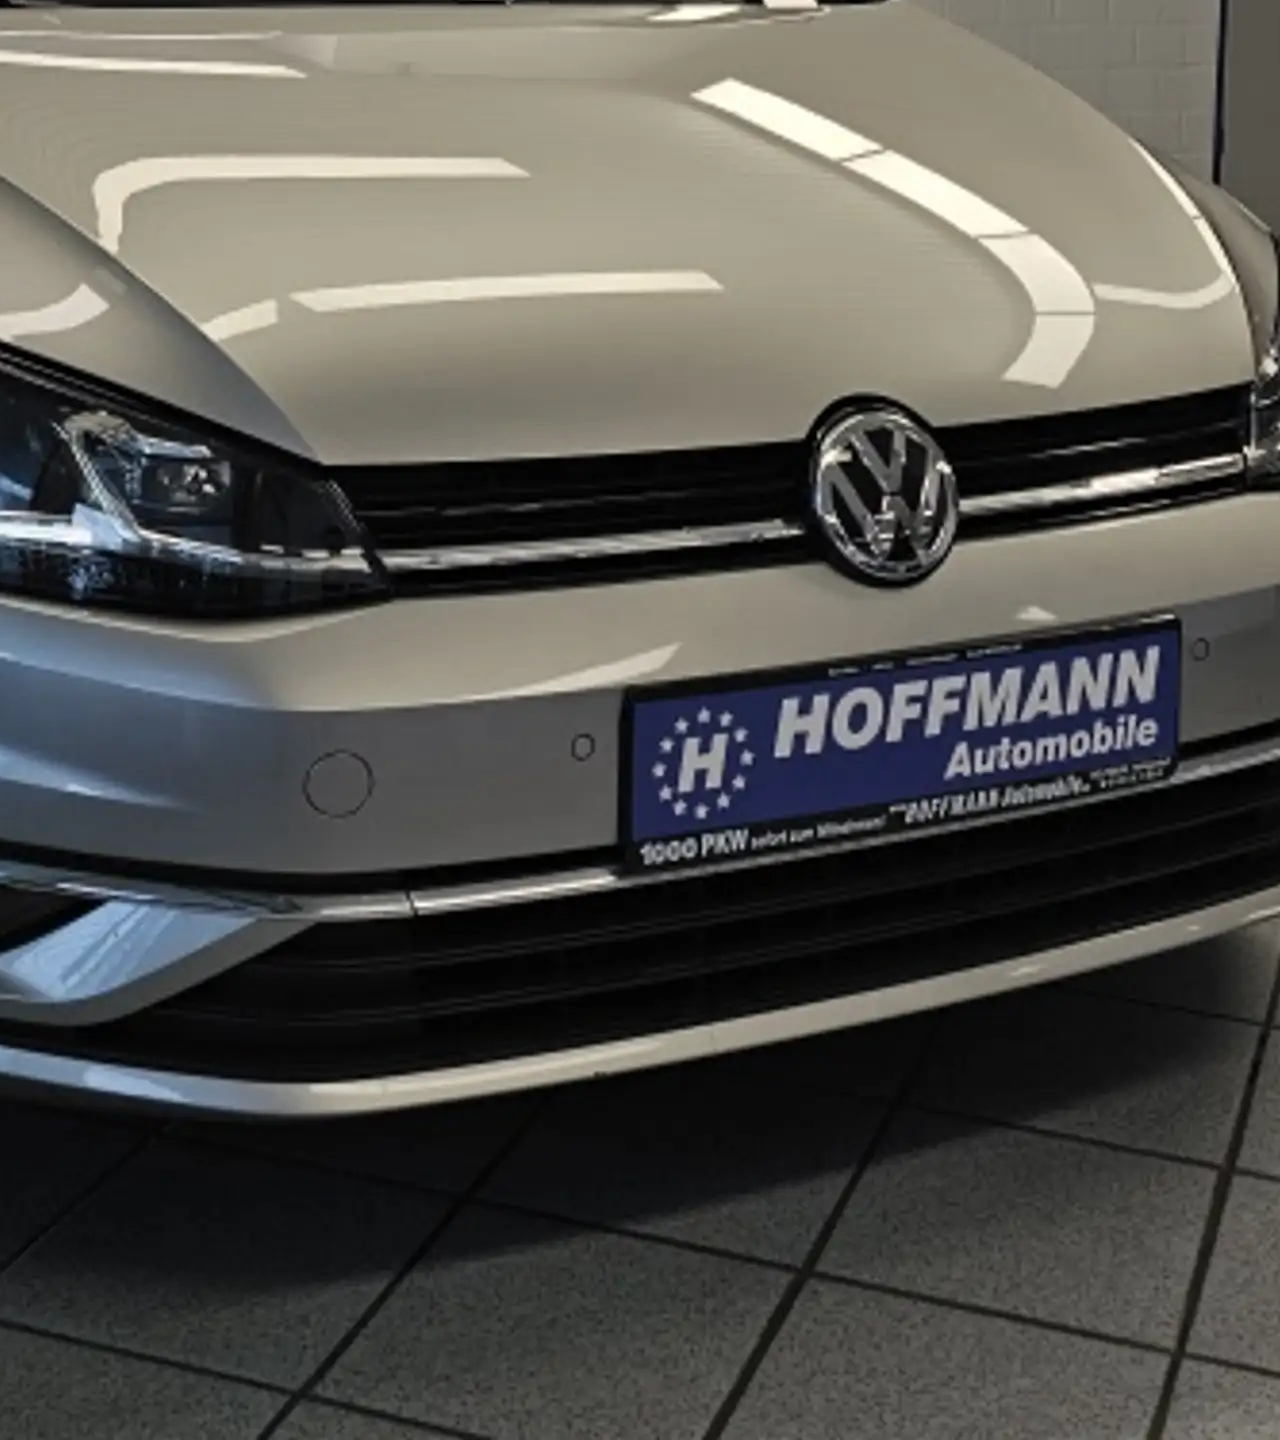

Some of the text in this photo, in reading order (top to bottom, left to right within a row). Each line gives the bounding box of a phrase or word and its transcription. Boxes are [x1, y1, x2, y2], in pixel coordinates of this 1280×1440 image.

[773, 645, 1162, 760] HOFFMANN
[677, 732, 729, 793] H
[943, 713, 1159, 780] Automobile
[640, 837, 699, 866] 1000
[700, 827, 749, 857] PKW
